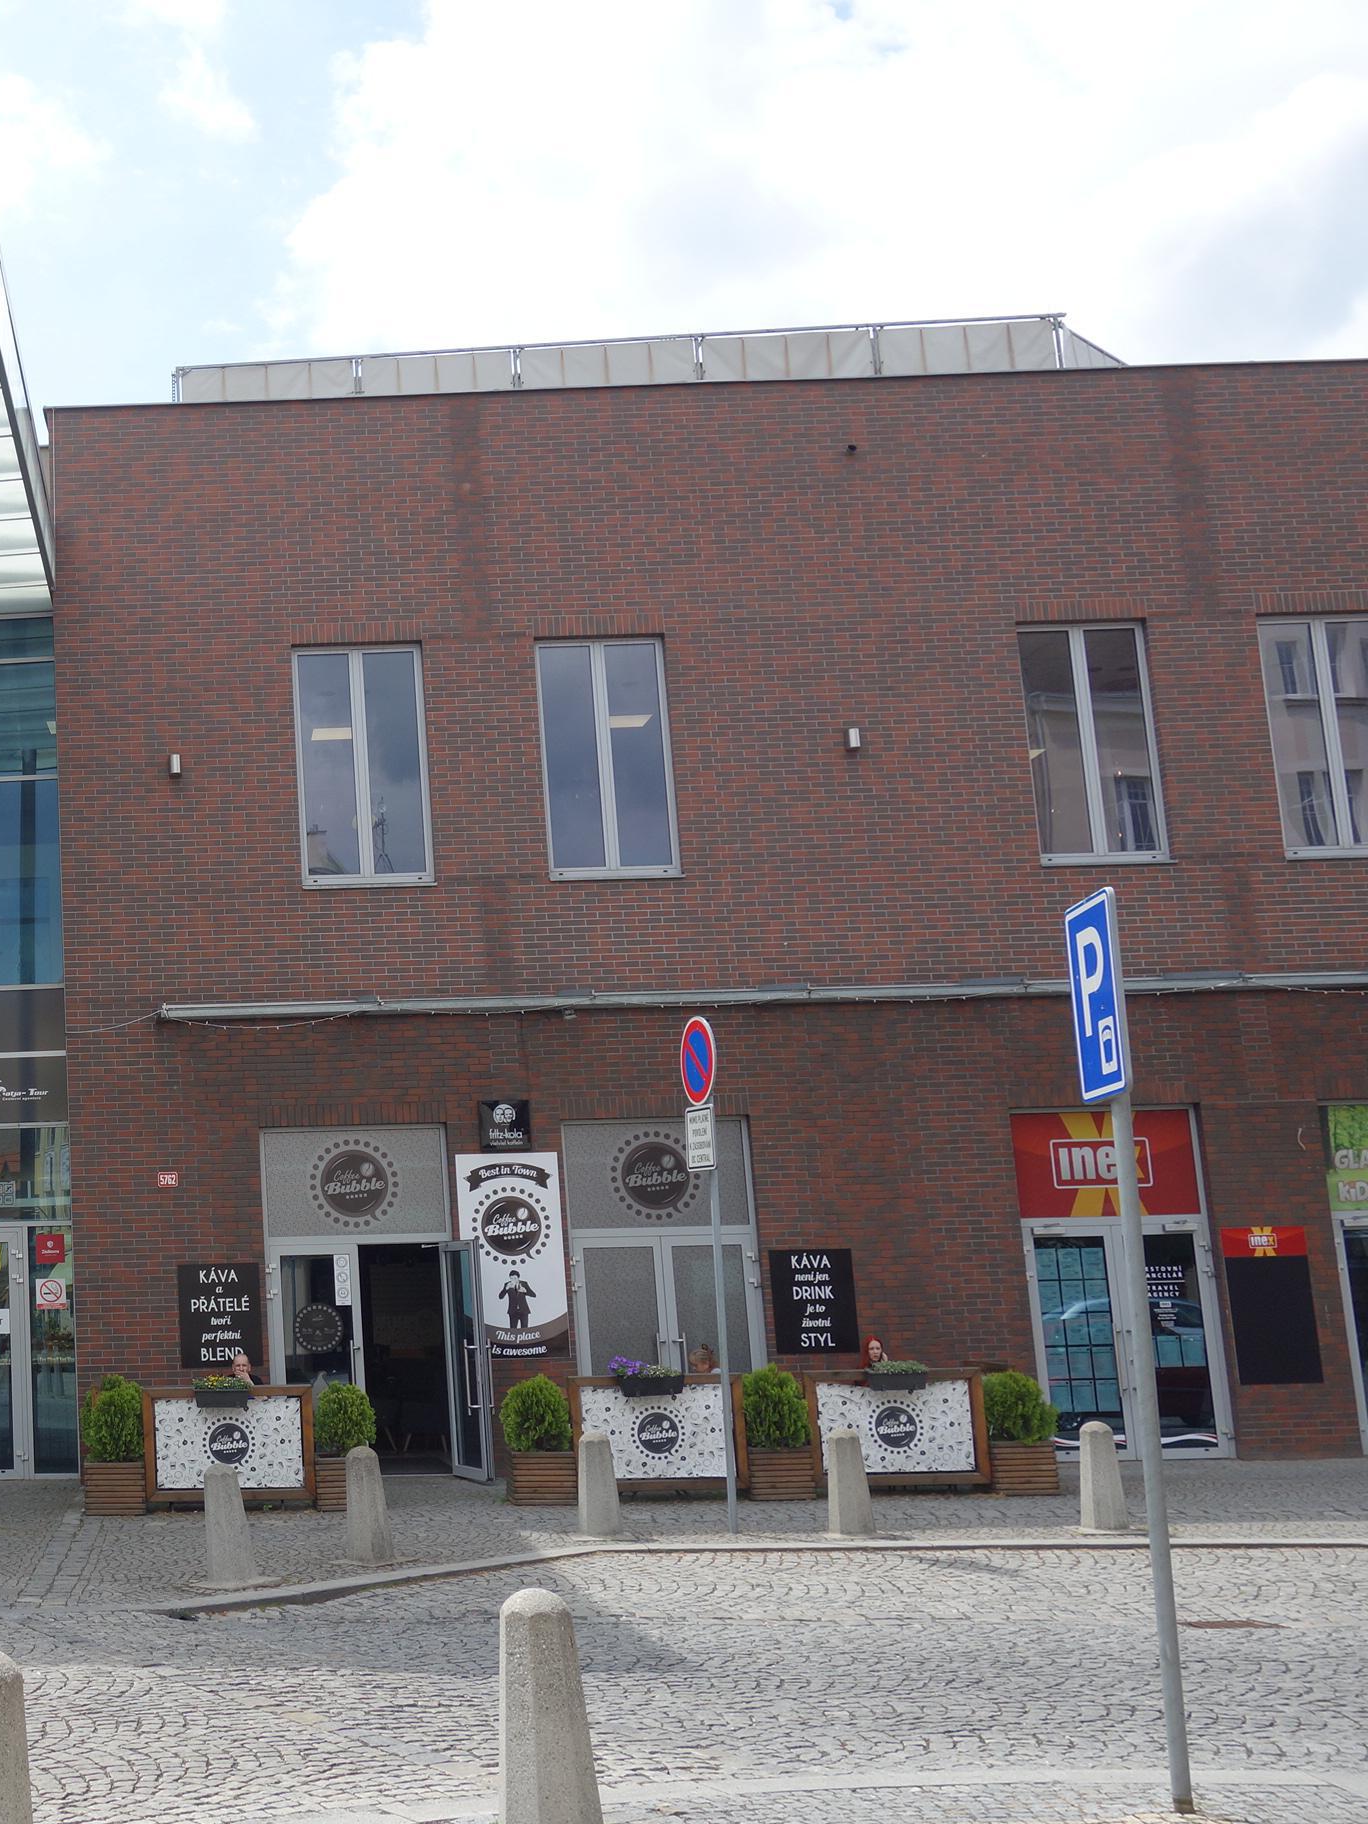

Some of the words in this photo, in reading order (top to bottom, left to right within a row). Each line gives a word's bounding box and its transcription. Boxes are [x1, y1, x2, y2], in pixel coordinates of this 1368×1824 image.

[1076, 926, 1104, 1037] P
[478, 1167, 501, 1179] Best
[501, 1165, 511, 1175] in
[512, 1165, 538, 1178] Town
[634, 1161, 662, 1176] Coffee
[159, 1174, 176, 1185] 5762
[334, 1169, 361, 1184] Coffee
[625, 1169, 688, 1187] Bubble
[324, 1177, 386, 1195] Bubble
[493, 1214, 516, 1226] Coffee
[484, 1221, 540, 1237] Bubble
[791, 1252, 831, 1269] KÁVA
[199, 1267, 239, 1284] KÁVA
[794, 1271, 814, 1281] není
[813, 1271, 830, 1283] jen
[215, 1286, 224, 1294] a
[792, 1285, 834, 1300] DRINK
[190, 1294, 250, 1313] PŘÁTELÉ
[805, 1303, 815, 1316] je
[815, 1303, 826, 1313] to
[210, 1315, 232, 1326] tvoří
[801, 1317, 831, 1328] životní
[201, 1330, 241, 1343] perfektní
[496, 1330, 516, 1341] This
[516, 1331, 541, 1343] place
[800, 1332, 836, 1347] STYL
[491, 1344, 502, 1354] is
[502, 1345, 548, 1356] awesome
[639, 1429, 678, 1440] Bubble
[877, 1423, 916, 1435] Bubble
[210, 1440, 248, 1451] Bubble
